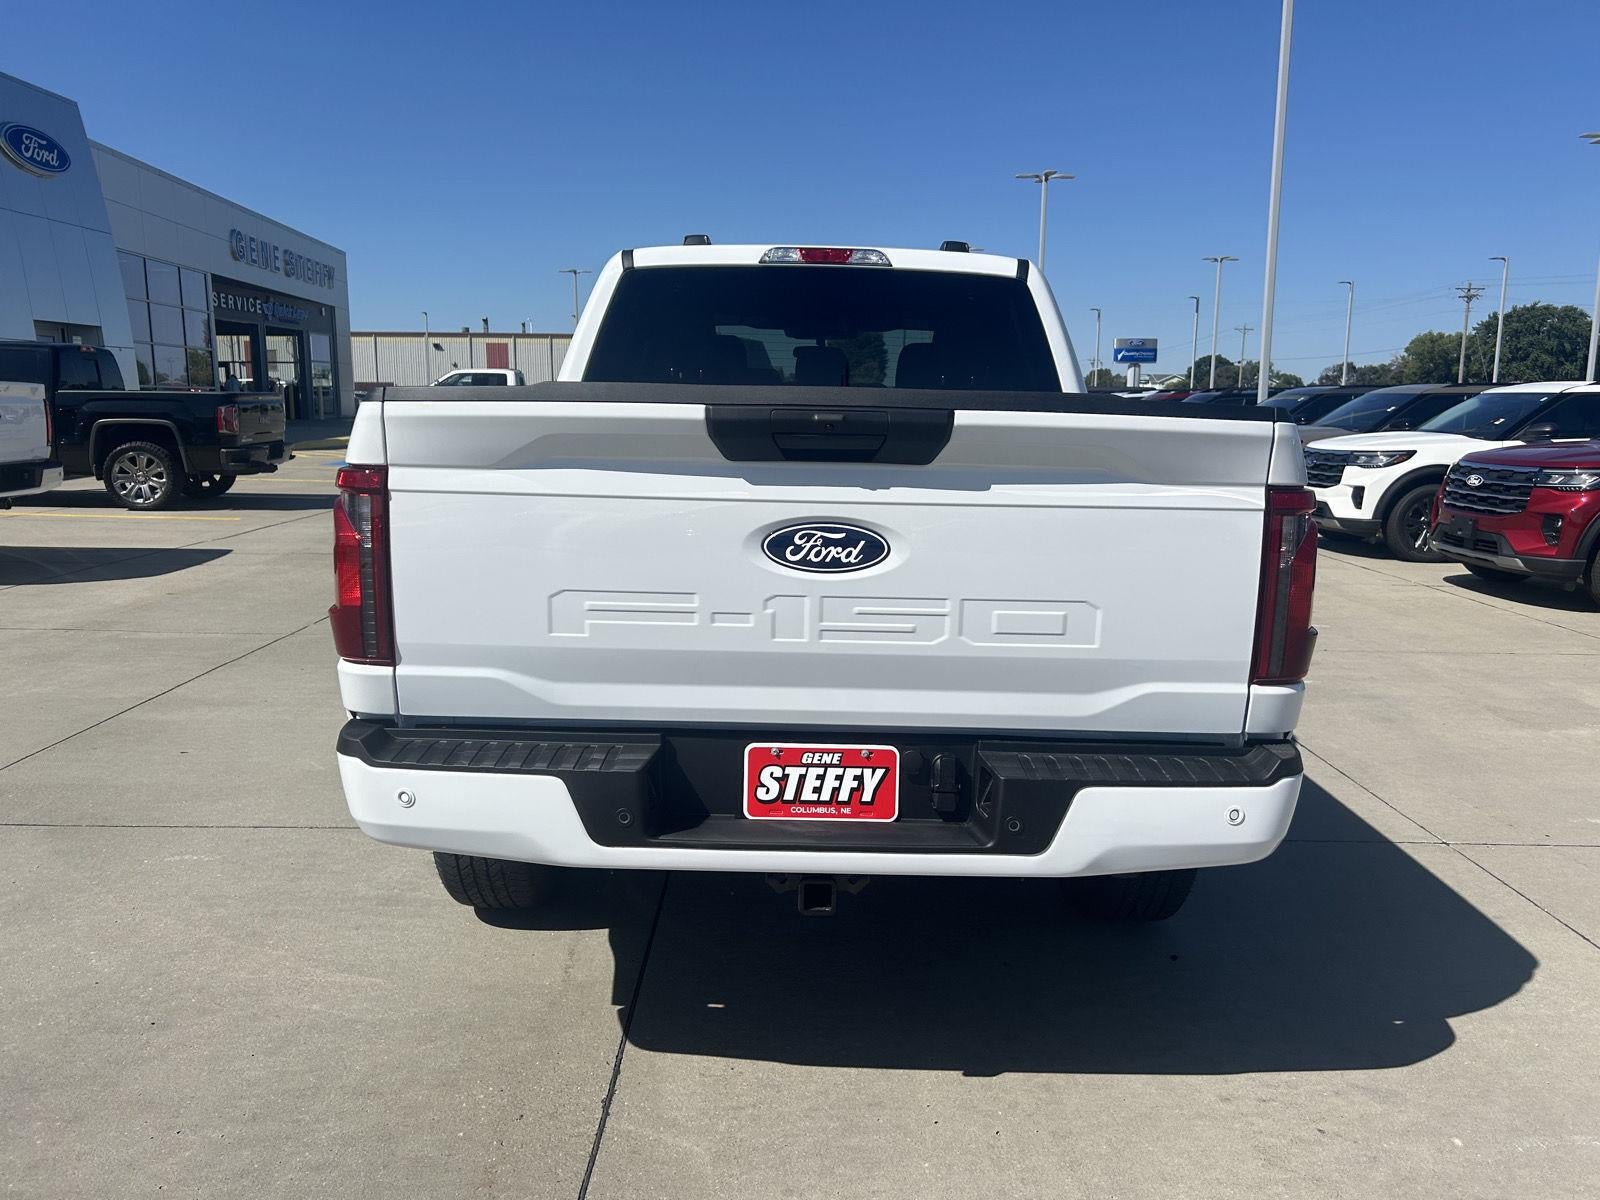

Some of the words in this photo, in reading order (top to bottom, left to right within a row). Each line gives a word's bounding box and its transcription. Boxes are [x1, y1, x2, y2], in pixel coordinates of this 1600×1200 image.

[22, 133, 59, 167] Ford
[230, 228, 281, 274] GENE
[283, 248, 335, 289] STEFFY
[212, 291, 263, 314] SERVICE
[785, 529, 867, 565] Ford
[548, 588, 1103, 648] F-150
[801, 752, 843, 765] GENE
[756, 765, 888, 804] STEFFY
[790, 806, 838, 815] COLUMBUS,
[840, 807, 852, 815] NE
